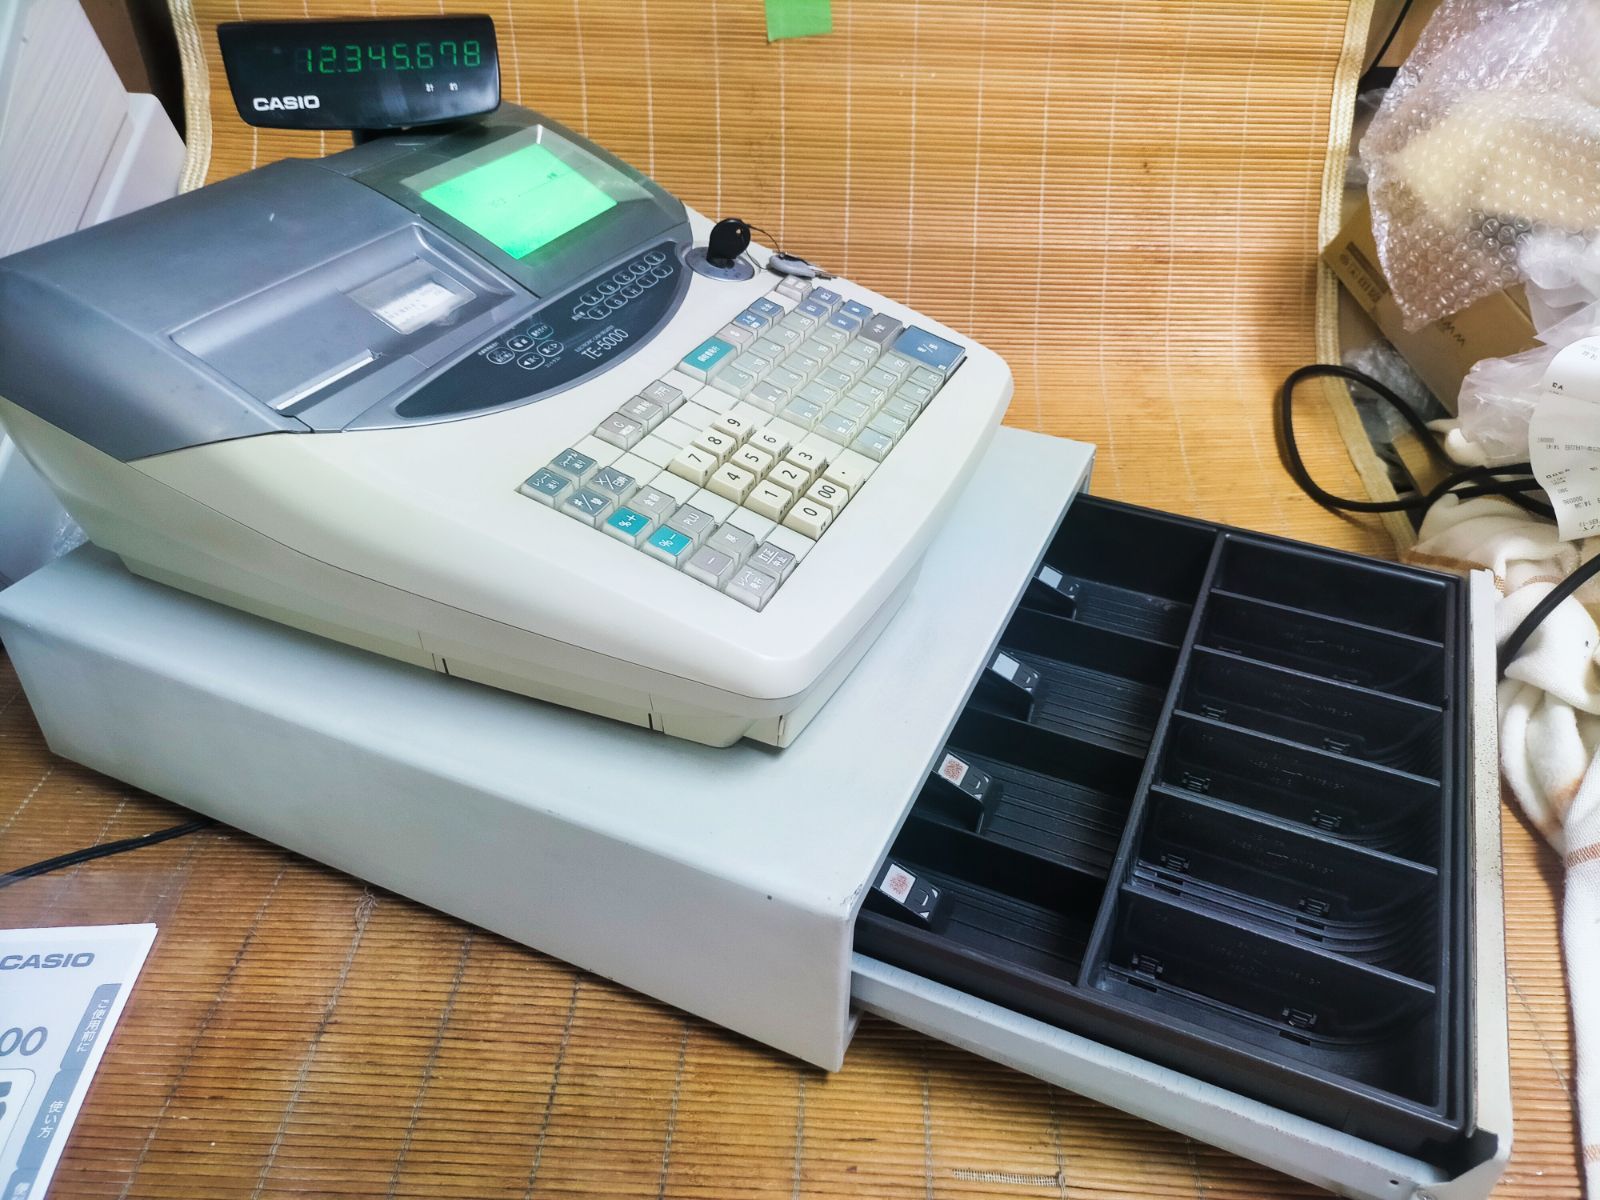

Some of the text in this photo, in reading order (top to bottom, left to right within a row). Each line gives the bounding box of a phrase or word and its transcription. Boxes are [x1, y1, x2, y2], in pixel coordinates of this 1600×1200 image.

[253, 95, 320, 111] CASIO
[581, 328, 629, 360] TE-5000
[727, 418, 741, 427] 9
[707, 436, 722, 445] 8
[763, 434, 777, 444] 6
[688, 453, 702, 462] 7
[745, 453, 759, 462] 5
[798, 452, 813, 461] 3
[727, 472, 741, 481] 4
[782, 470, 797, 479] 2
[764, 490, 778, 498] 1
[817, 485, 836, 499] 00
[803, 507, 818, 516] 0
[618, 513, 636, 528] %+
[683, 512, 699, 526] PLU
[0, 953, 95, 971] CASIO
[77, 999, 110, 1052] ご使用前に
[37, 1100, 64, 1138] 使い方
